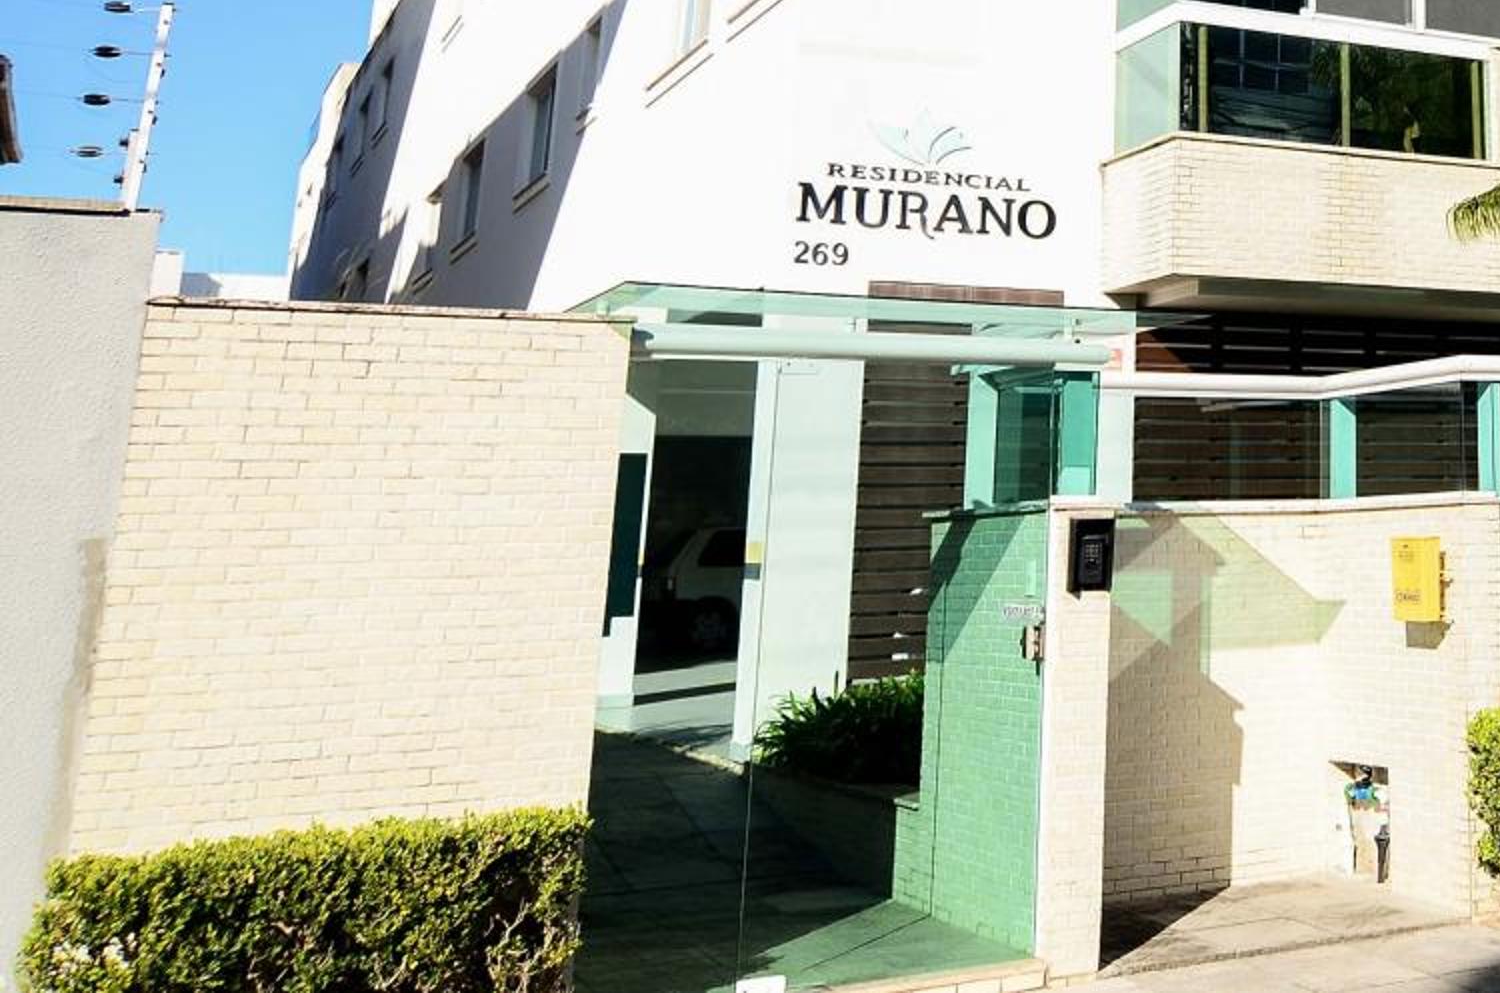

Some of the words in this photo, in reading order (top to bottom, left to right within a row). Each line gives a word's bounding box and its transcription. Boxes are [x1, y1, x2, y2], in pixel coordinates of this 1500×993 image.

[827, 162, 1031, 192] RESIDENCIAL
[795, 182, 1057, 240] MURANO
[793, 241, 850, 266] 269
